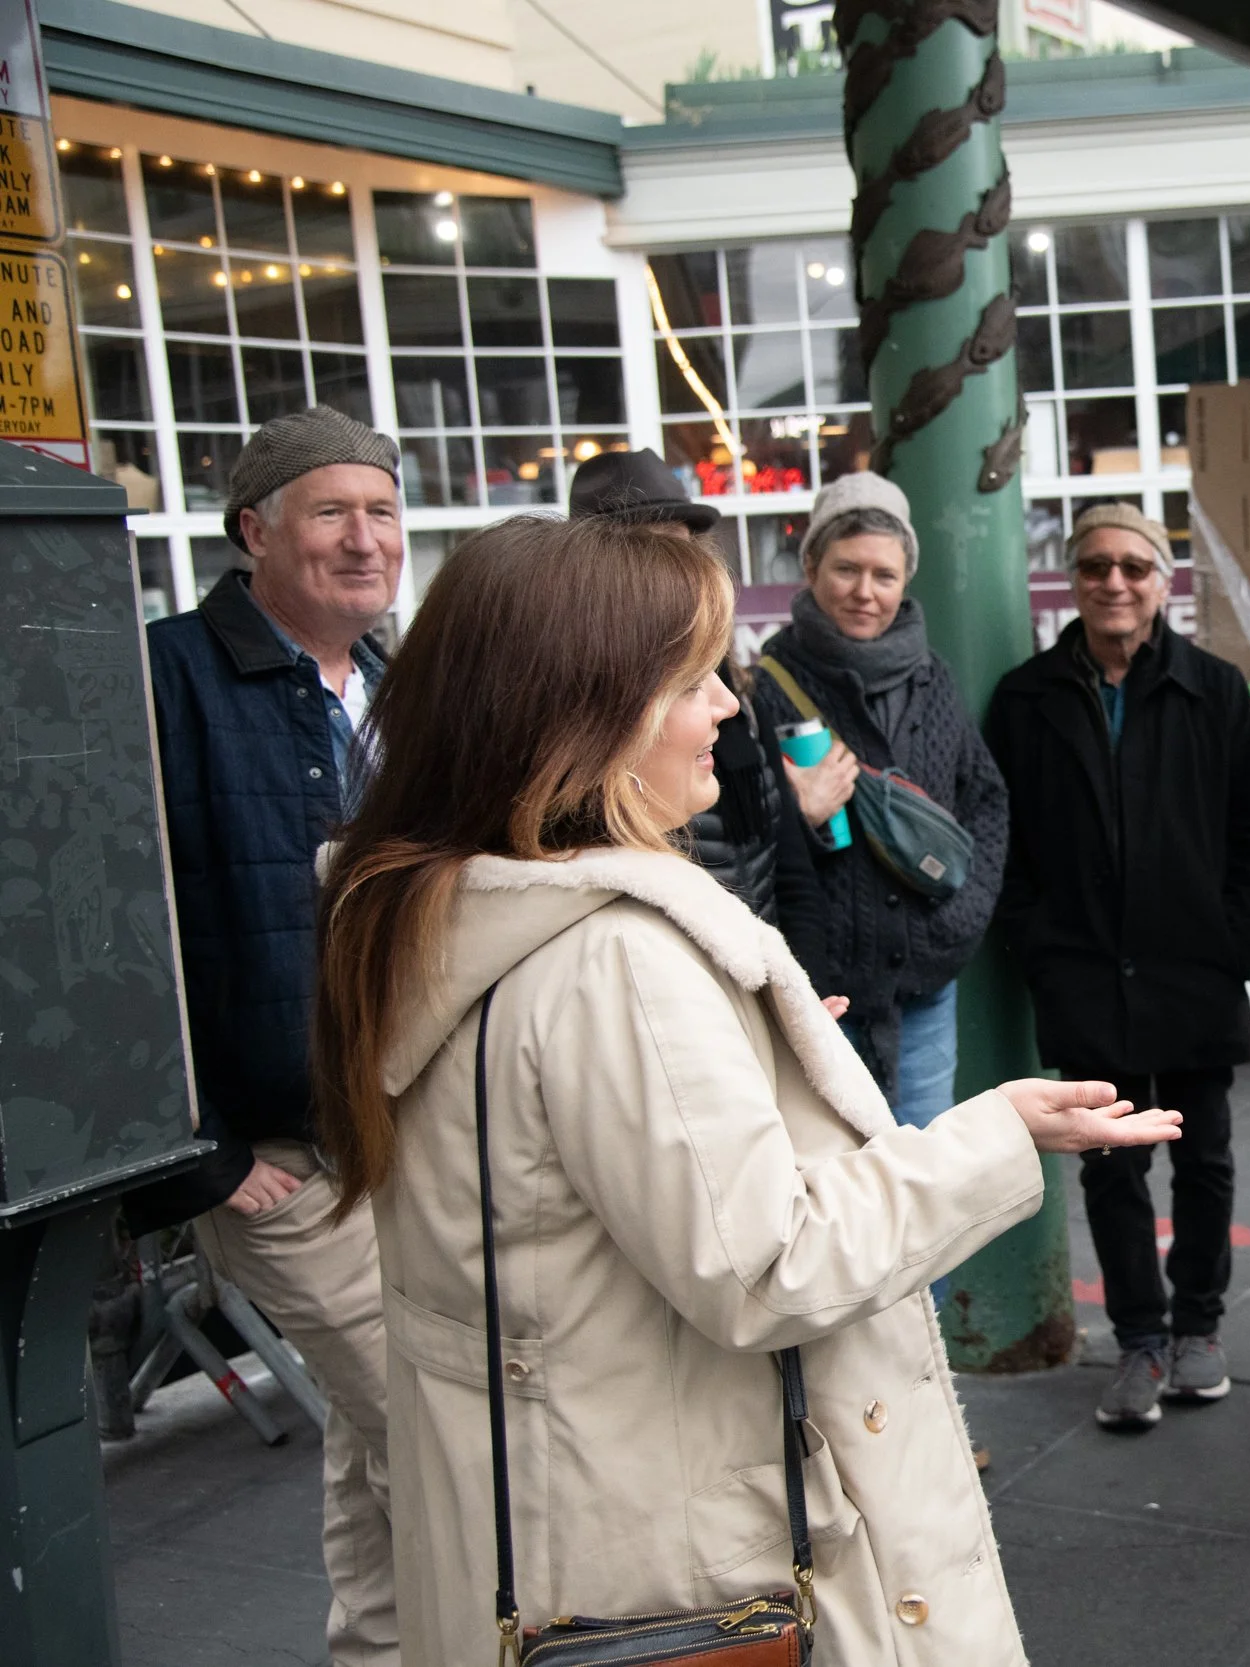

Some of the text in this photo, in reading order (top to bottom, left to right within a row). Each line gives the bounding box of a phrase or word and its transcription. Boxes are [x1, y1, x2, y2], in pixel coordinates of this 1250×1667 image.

[0, 118, 32, 141] TE
[0, 194, 31, 217] AM
[1, 261, 58, 288] NUTE
[12, 297, 52, 325] AND
[1, 327, 46, 355] OAD
